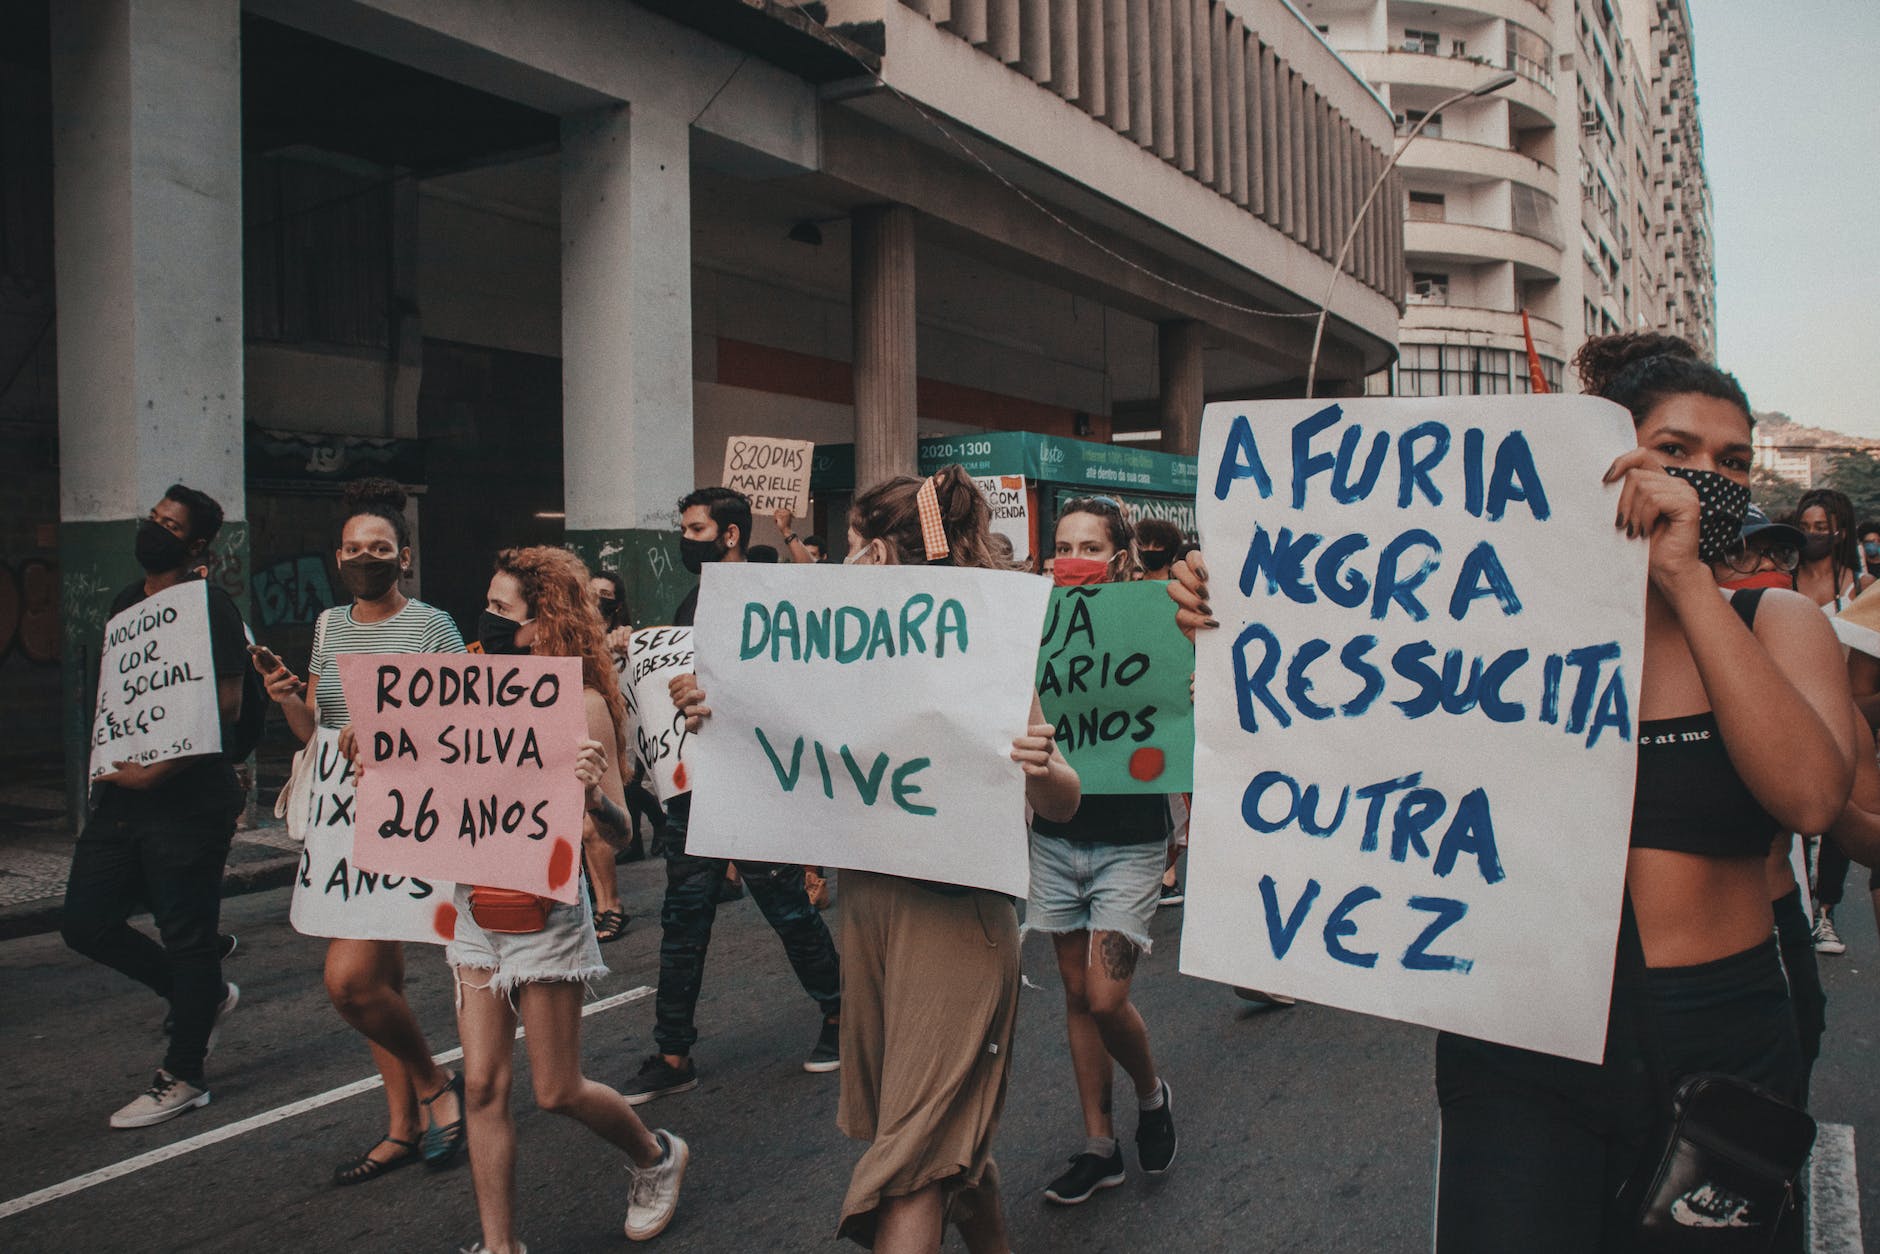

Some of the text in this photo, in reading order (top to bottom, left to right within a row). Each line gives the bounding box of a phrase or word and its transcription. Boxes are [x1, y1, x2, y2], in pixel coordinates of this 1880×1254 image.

[730, 441, 771, 471] 820
[771, 446, 804, 472] DIAS
[921, 441, 991, 458] 2020-1300
[1215, 403, 1551, 522] A FURIA
[729, 474, 802, 492] MARIELLE
[990, 491, 1019, 504] COM
[1239, 521, 1523, 622] NEGRA
[739, 592, 968, 665] DANDARA
[119, 640, 160, 674] COR
[123, 661, 203, 705] SOCIAL
[377, 665, 559, 713] RODRIGO
[1232, 622, 1631, 749] RESSUCITA
[374, 725, 543, 769] DA SILVA
[1054, 705, 1157, 754] ANOS
[1655, 733, 1676, 744] at
[1681, 730, 1711, 742] me
[755, 726, 937, 816] VIVE
[378, 787, 549, 848] 26 ANOS
[1241, 770, 1506, 885] OUTRA
[1258, 875, 1474, 974] VEZ
